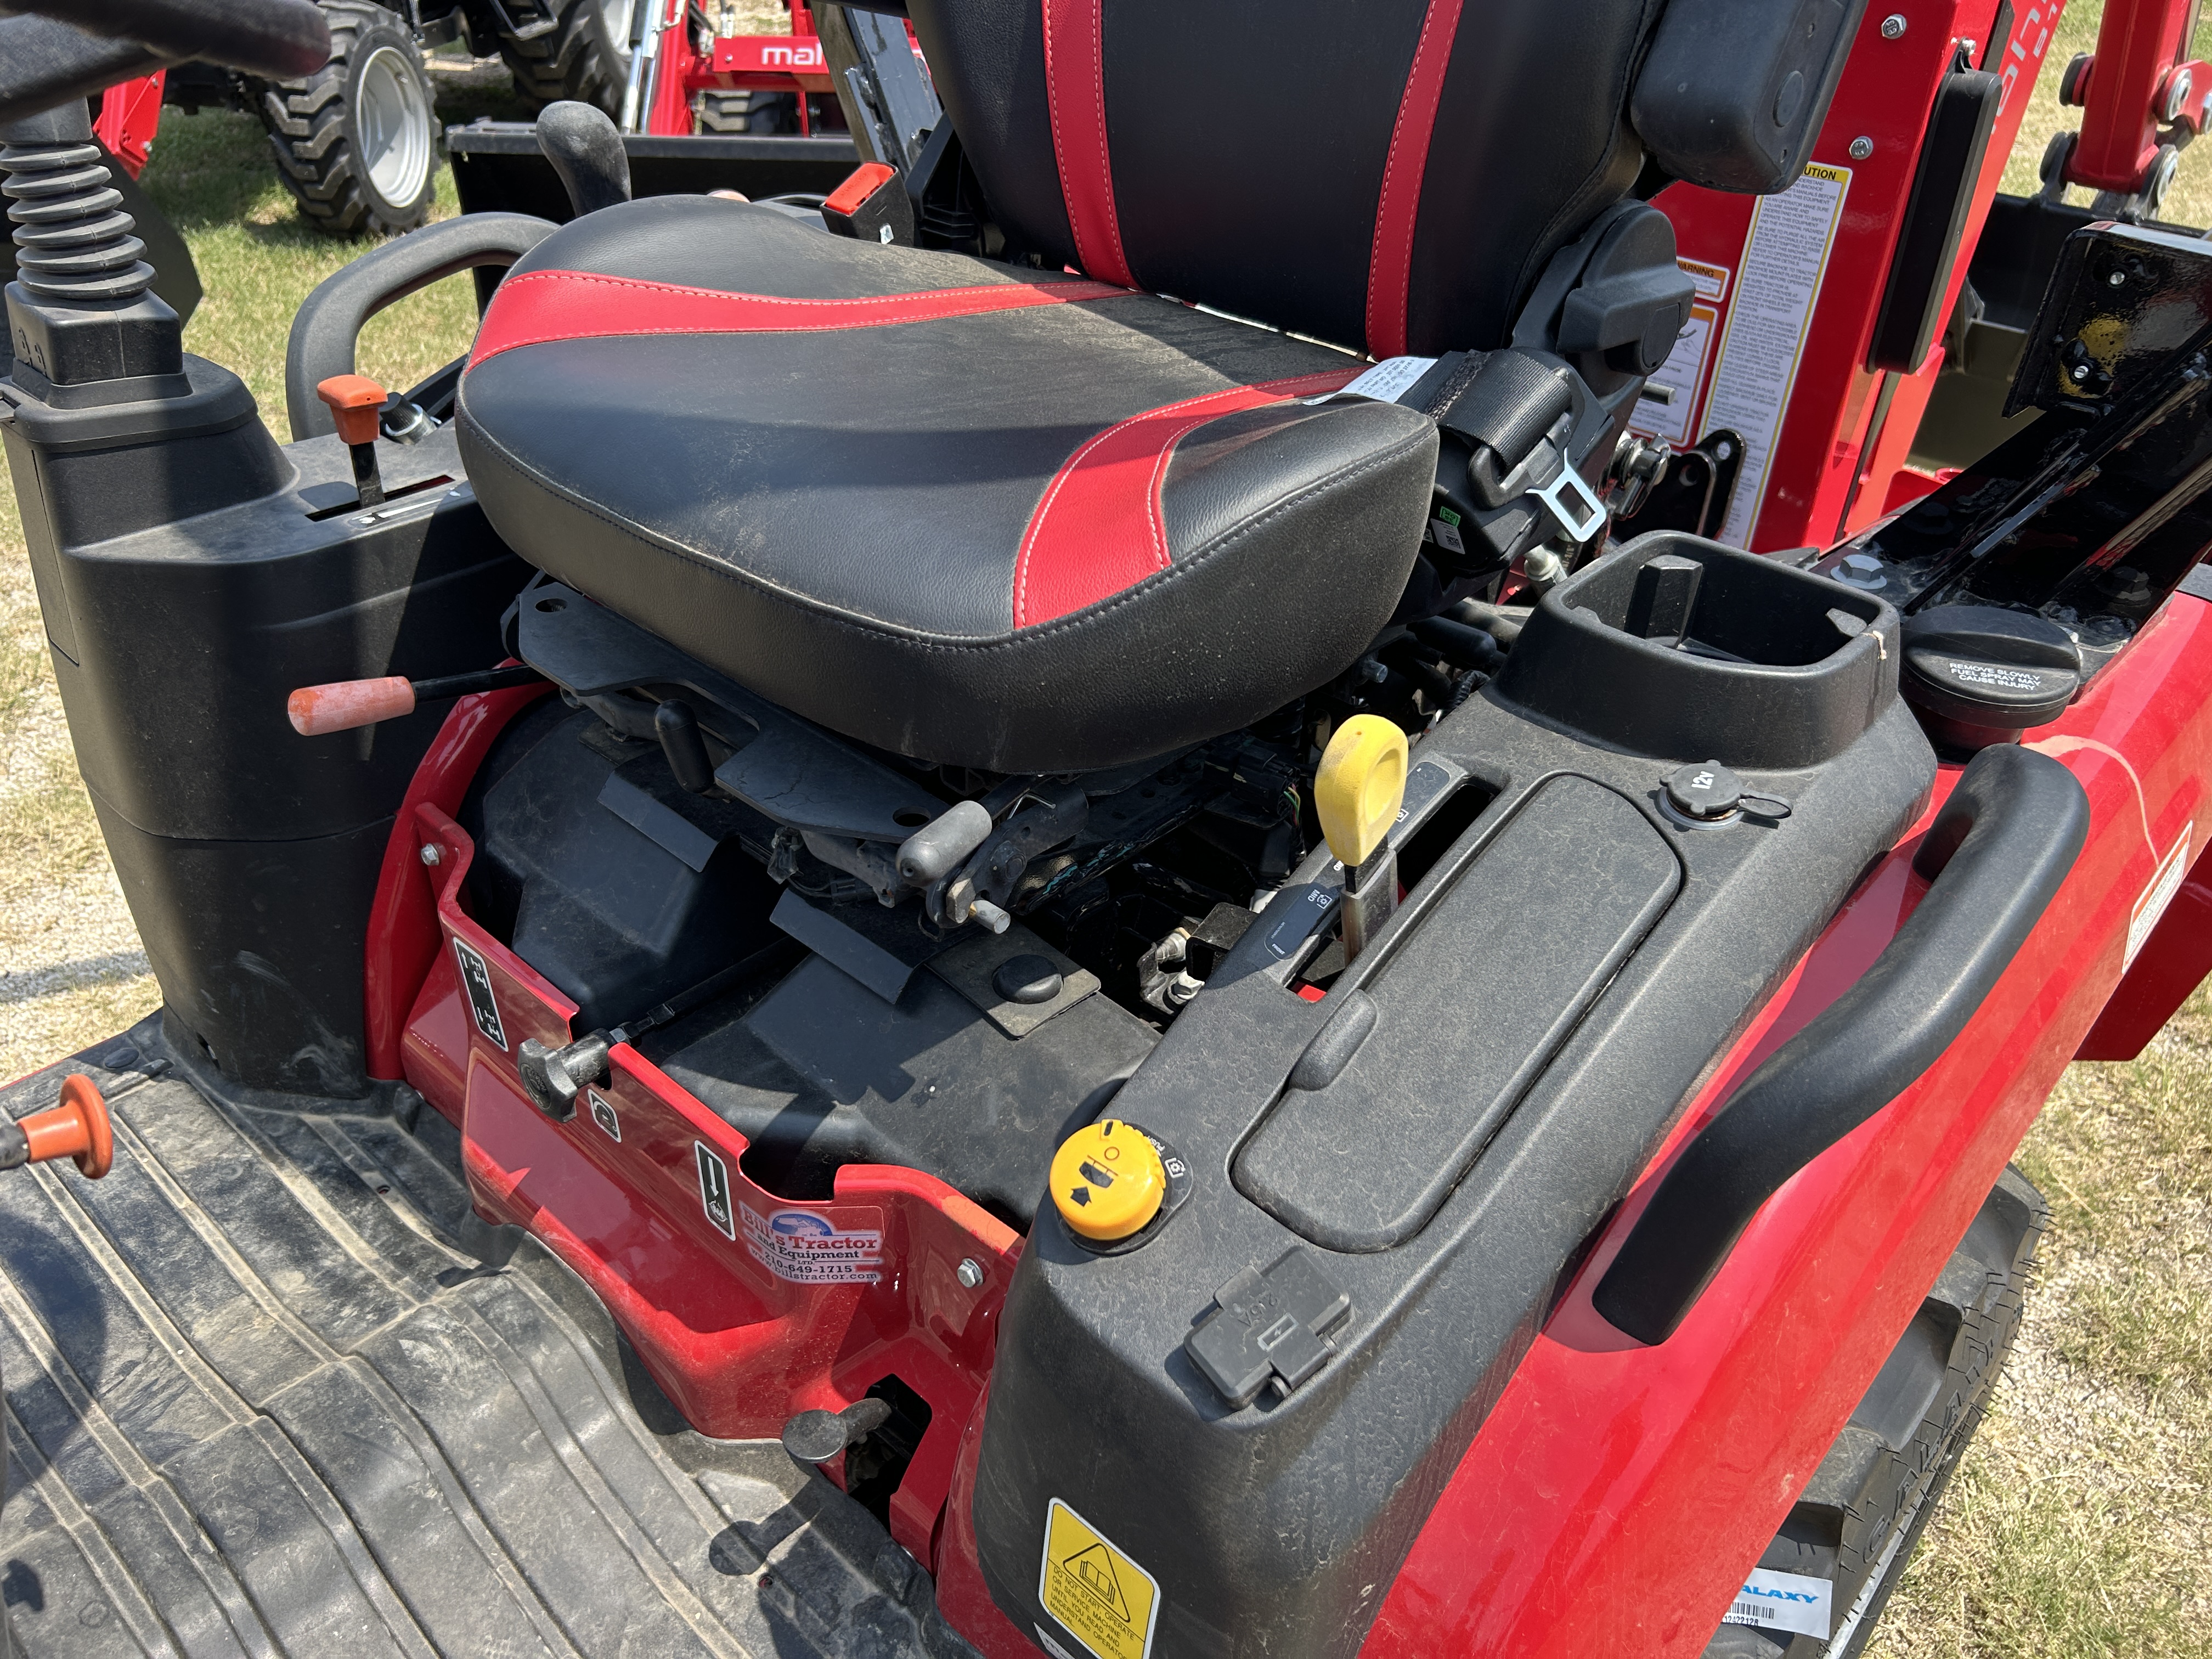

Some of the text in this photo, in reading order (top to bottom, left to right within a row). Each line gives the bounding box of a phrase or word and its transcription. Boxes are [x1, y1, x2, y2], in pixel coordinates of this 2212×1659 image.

[1797, 177, 1825, 186] NDERSTAND
[1804, 167, 1836, 180] UTION
[1949, 662, 2040, 681] REMOVE SLOWLY
[1951, 668, 2041, 686] FUEL SPRAY MAY
[1959, 675, 2035, 691] CAUSE INJURY
[1307, 889, 1321, 902] MID
[1272, 943, 1286, 955] FRONT
[744, 1209, 785, 1245] Bill's
[788, 1235, 877, 1249] Tractor
[758, 1233, 860, 1261] and Equipment
[751, 1247, 877, 1280] www.billstractor.com
[765, 1251, 853, 1273] 210-649-1715
[1053, 1566, 1063, 1578] DO
[1065, 1576, 1078, 1591] NOT
[1104, 1612, 1135, 1641] OPERATE
[1741, 1584, 1819, 1604] ALAXY
[1050, 1600, 1075, 1628] MANUAL
[1051, 1591, 1091, 1632] UNDERSTAND
[1052, 1575, 1121, 1639] OR SERVICE MACHINE
[1052, 1583, 1120, 1647] UNTIL YOU READ AND
[1722, 1615, 1759, 1626] 12422128
